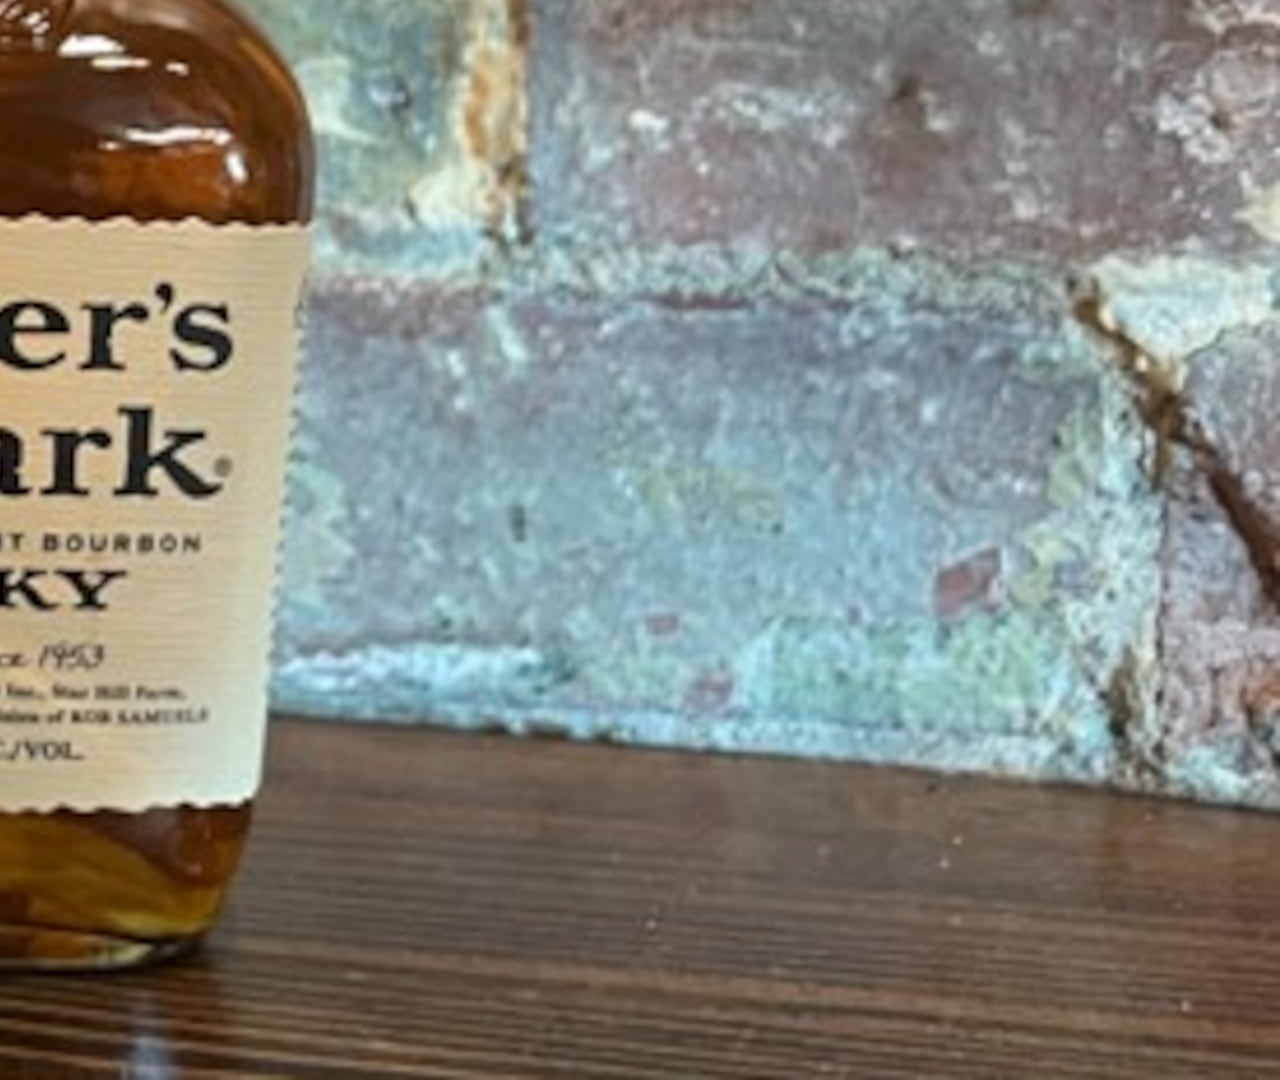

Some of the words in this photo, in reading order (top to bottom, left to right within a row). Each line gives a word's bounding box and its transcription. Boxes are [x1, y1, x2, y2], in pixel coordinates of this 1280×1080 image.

[42, 531, 202, 553] BOURBON
[38, 643, 105, 670] 1953
[52, 682, 89, 700] Star
[94, 683, 132, 700] Hill
[47, 709, 67, 724] of
[71, 709, 113, 725] ROB
